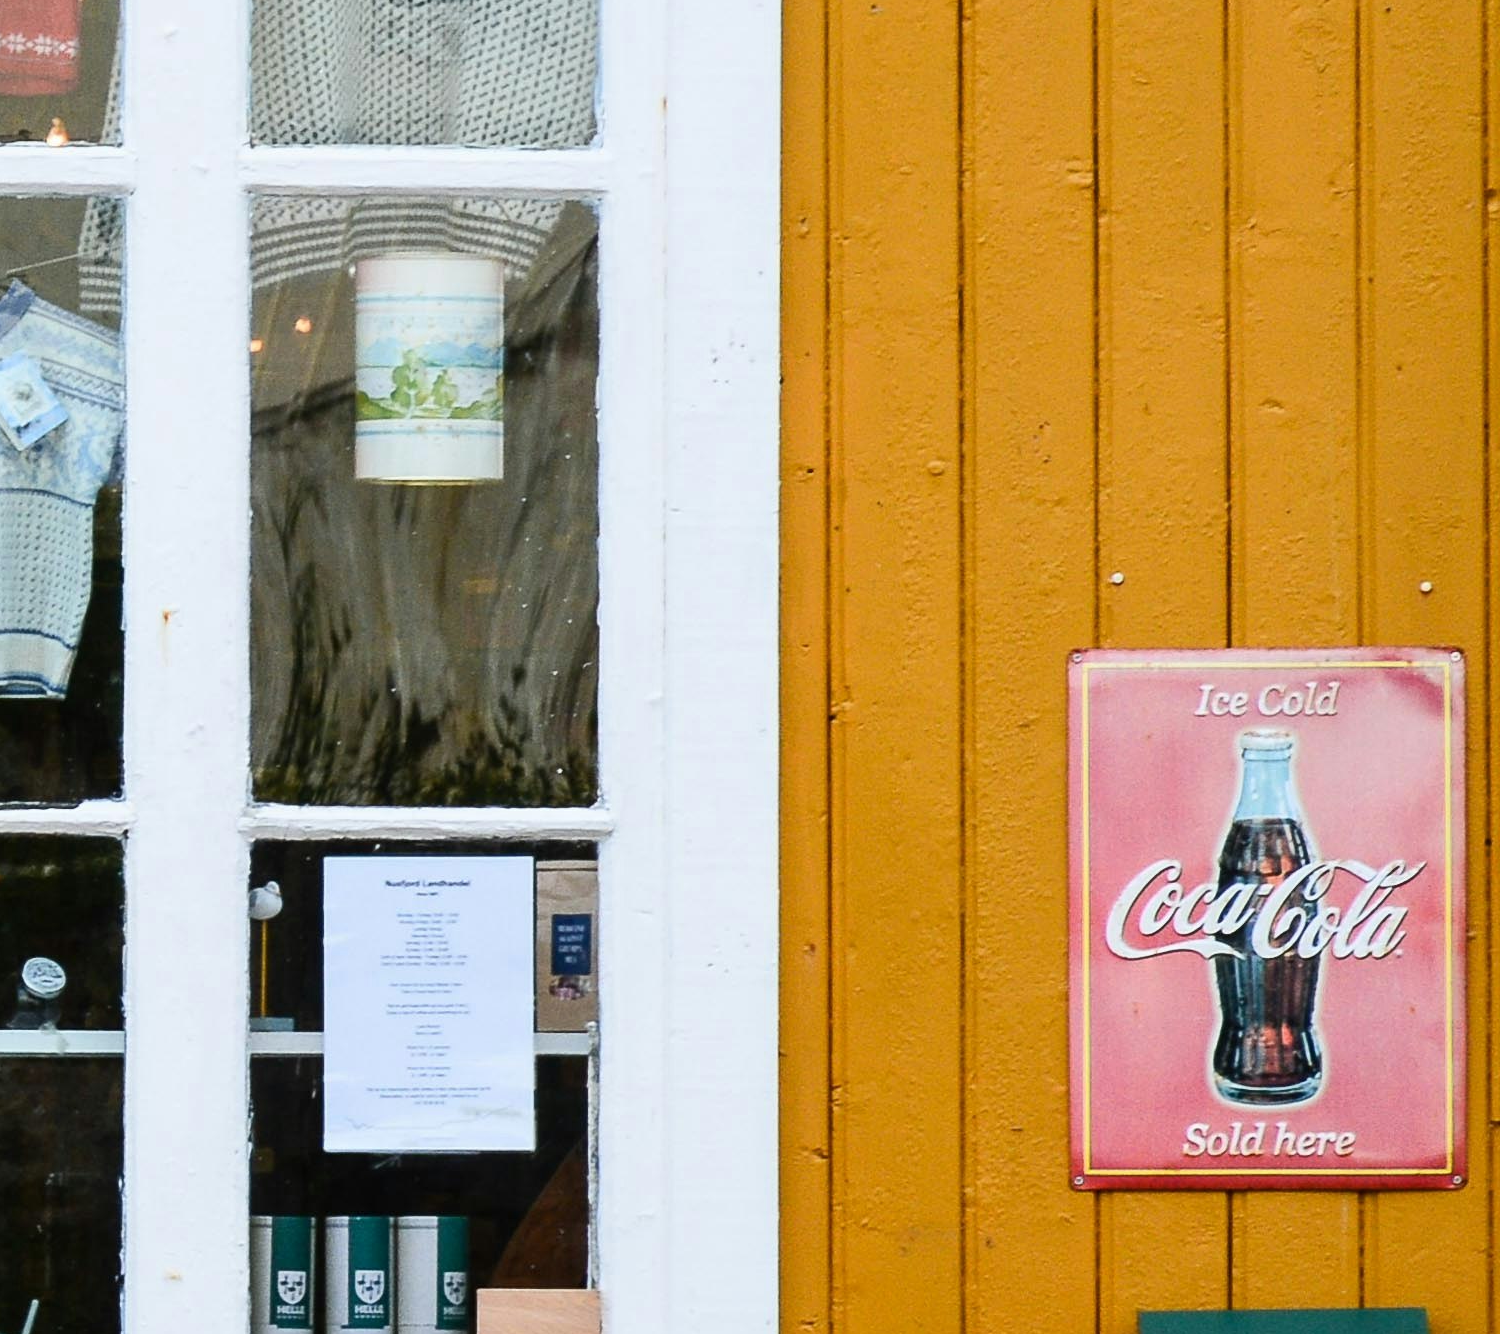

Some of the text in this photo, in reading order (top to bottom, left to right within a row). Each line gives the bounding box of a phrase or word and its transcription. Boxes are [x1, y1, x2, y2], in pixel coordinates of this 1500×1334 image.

[1194, 681, 1341, 717] Ice Cold
[1105, 858, 1428, 960] Coca-Cola
[1182, 1121, 1357, 1157] Sold here
